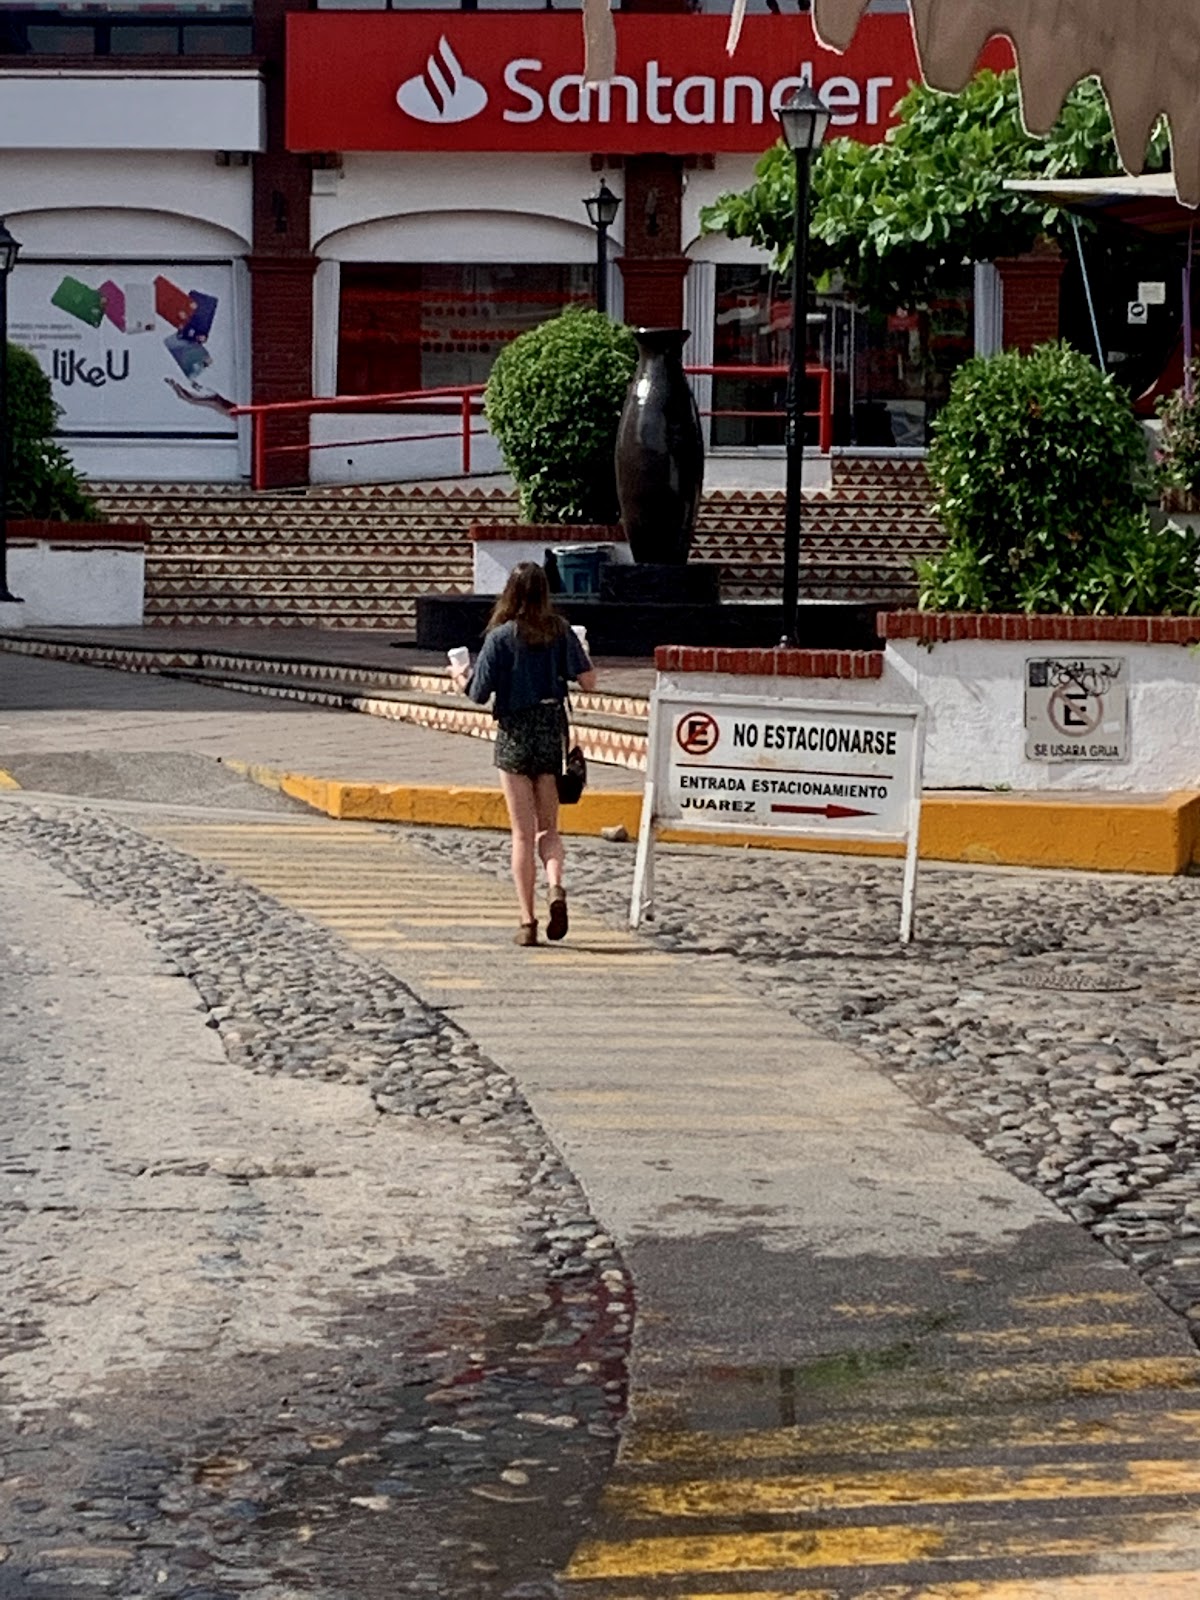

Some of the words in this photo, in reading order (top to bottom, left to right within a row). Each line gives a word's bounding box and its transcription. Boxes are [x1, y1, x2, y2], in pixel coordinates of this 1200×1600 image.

[503, 59, 893, 124] Santander
[733, 723, 758, 748] NO
[763, 725, 897, 755] ESTACIONARSE
[1034, 744, 1048, 756] SE
[680, 776, 746, 792] ENTRADA
[752, 779, 888, 799] ESTACIONAMIENTO
[680, 798, 756, 813] JUAREZ
